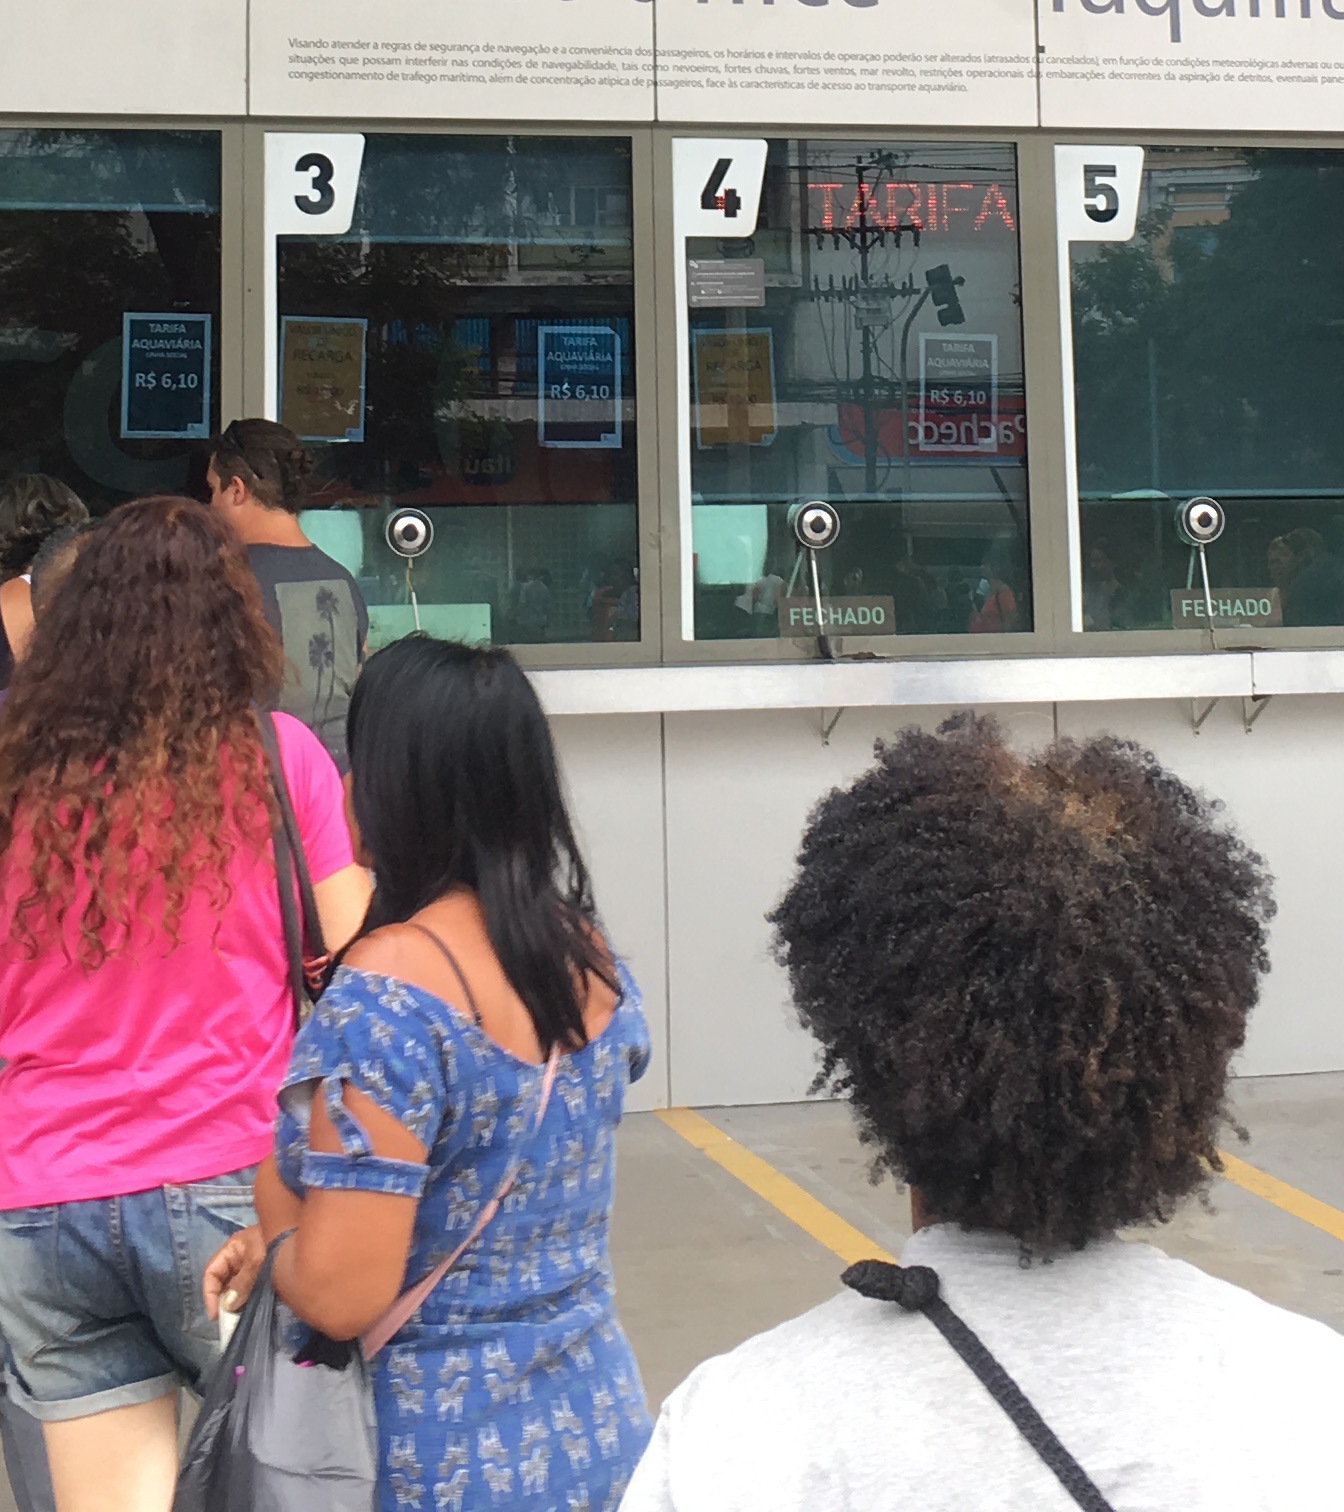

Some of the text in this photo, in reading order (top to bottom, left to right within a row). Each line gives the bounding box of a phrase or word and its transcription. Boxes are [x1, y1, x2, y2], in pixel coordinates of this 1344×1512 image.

[635, 46, 652, 56] dos
[294, 153, 336, 215] 3
[701, 158, 741, 218] 4
[1083, 165, 1119, 222] 5
[807, 182, 1016, 232] TARIFA
[149, 324, 187, 333] TARIFA
[132, 338, 202, 350] AQUAVIÁRIA
[563, 336, 597, 346] TARIFA
[136, 371, 198, 390] R$ 6,10
[576, 385, 609, 402] 6,10
[930, 388, 986, 406] R$ 6,10
[789, 607, 885, 626] FECHADO
[1181, 597, 1272, 618] FECHADO
